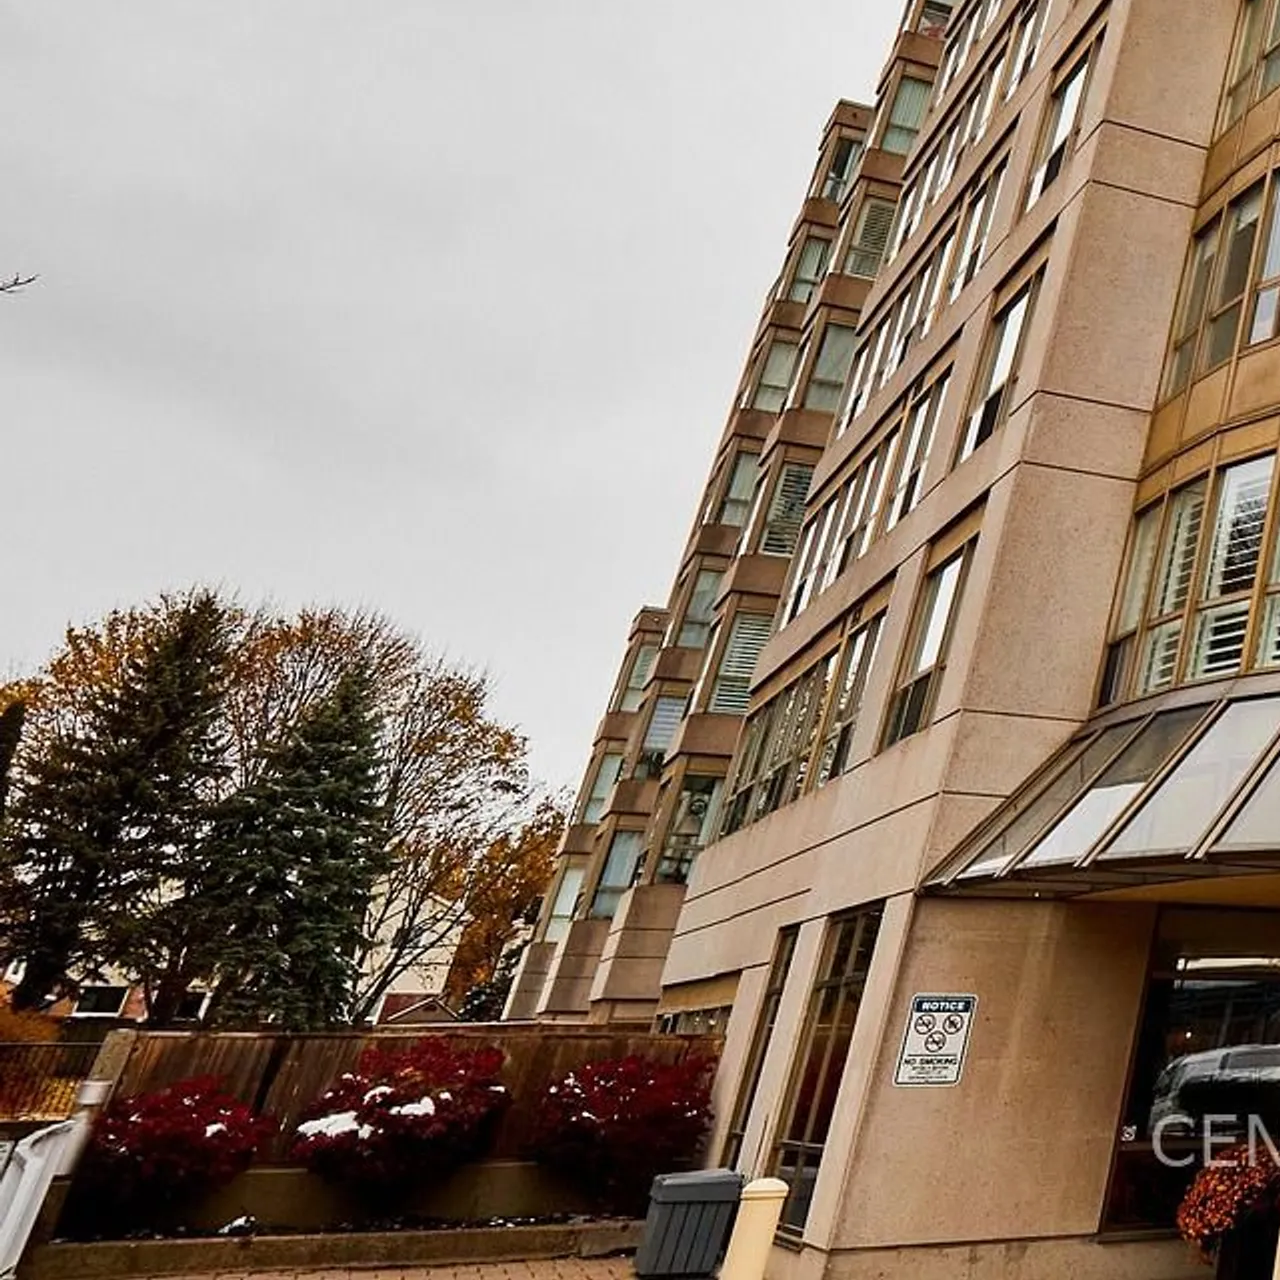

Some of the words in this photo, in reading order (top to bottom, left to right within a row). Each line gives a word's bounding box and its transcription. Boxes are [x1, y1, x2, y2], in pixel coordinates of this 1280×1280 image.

[921, 1002, 966, 1012] NOTICE
[904, 1058, 917, 1066] NO
[919, 1058, 958, 1066] SMOKING
